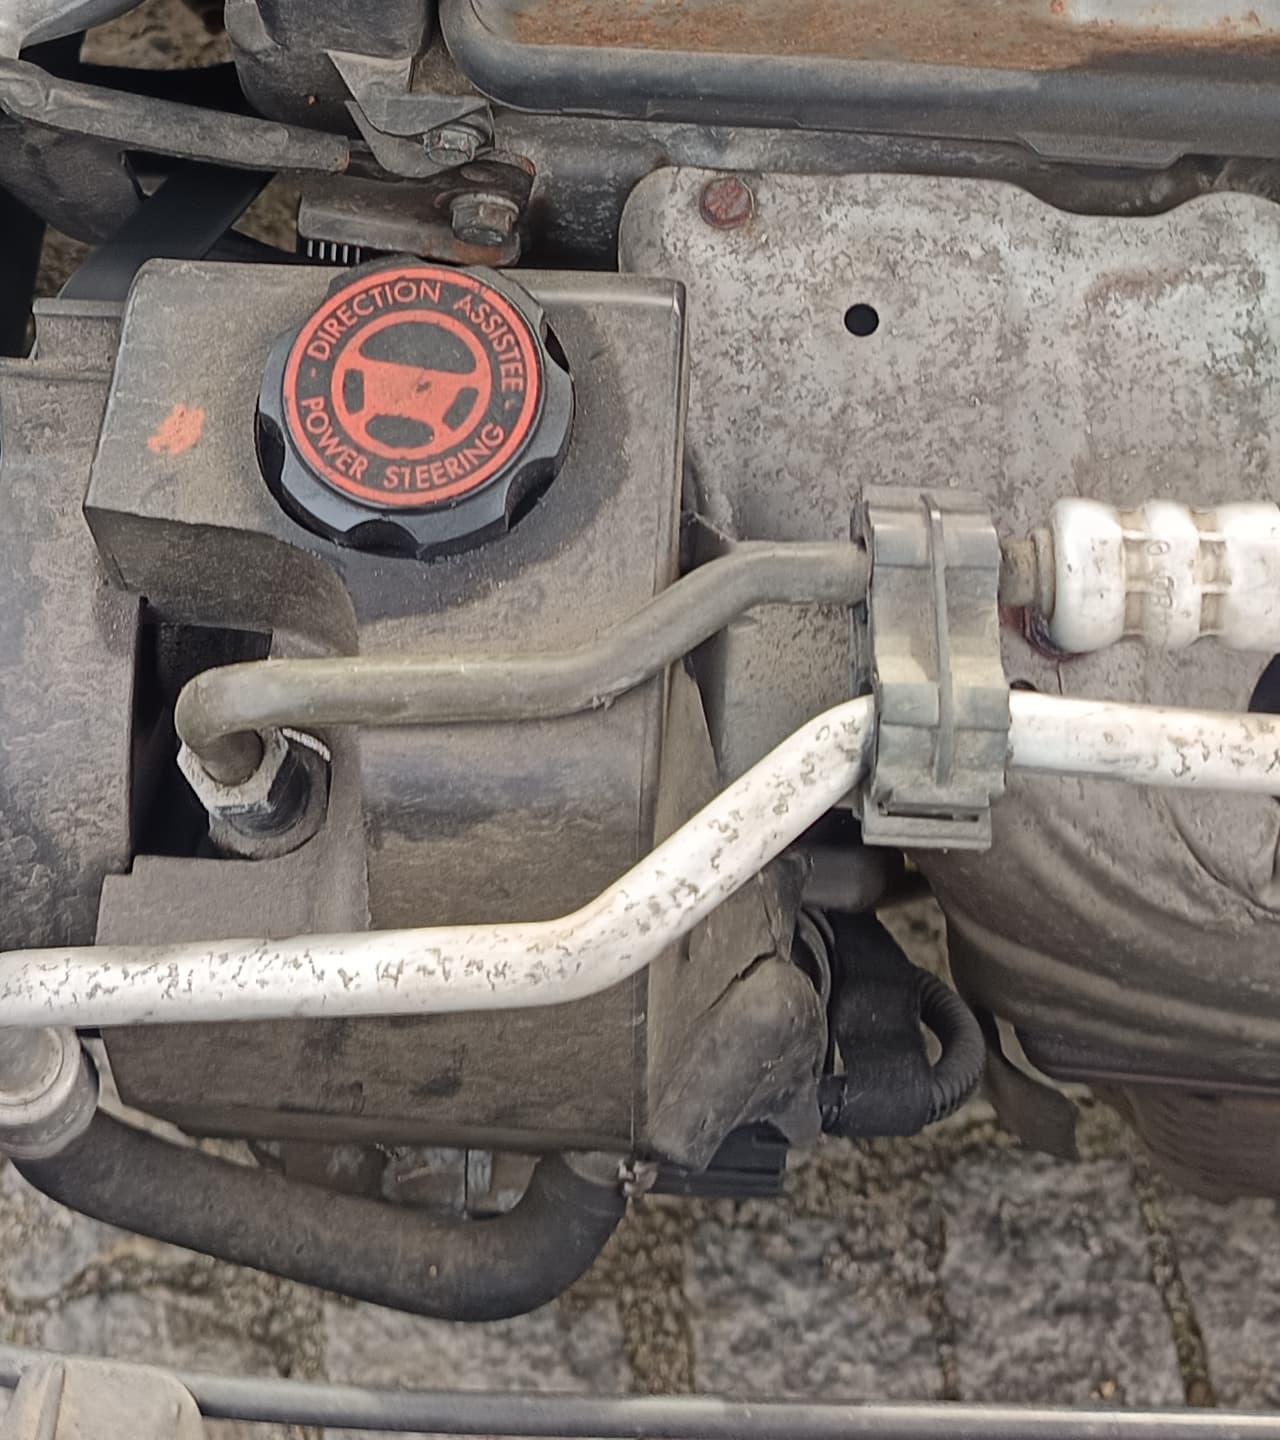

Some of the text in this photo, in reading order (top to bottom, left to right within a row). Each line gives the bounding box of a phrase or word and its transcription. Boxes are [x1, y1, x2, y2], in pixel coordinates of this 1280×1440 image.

[306, 281, 524, 393] DIRECTION ASSISTEE
[301, 396, 506, 490] POWER STEERING
